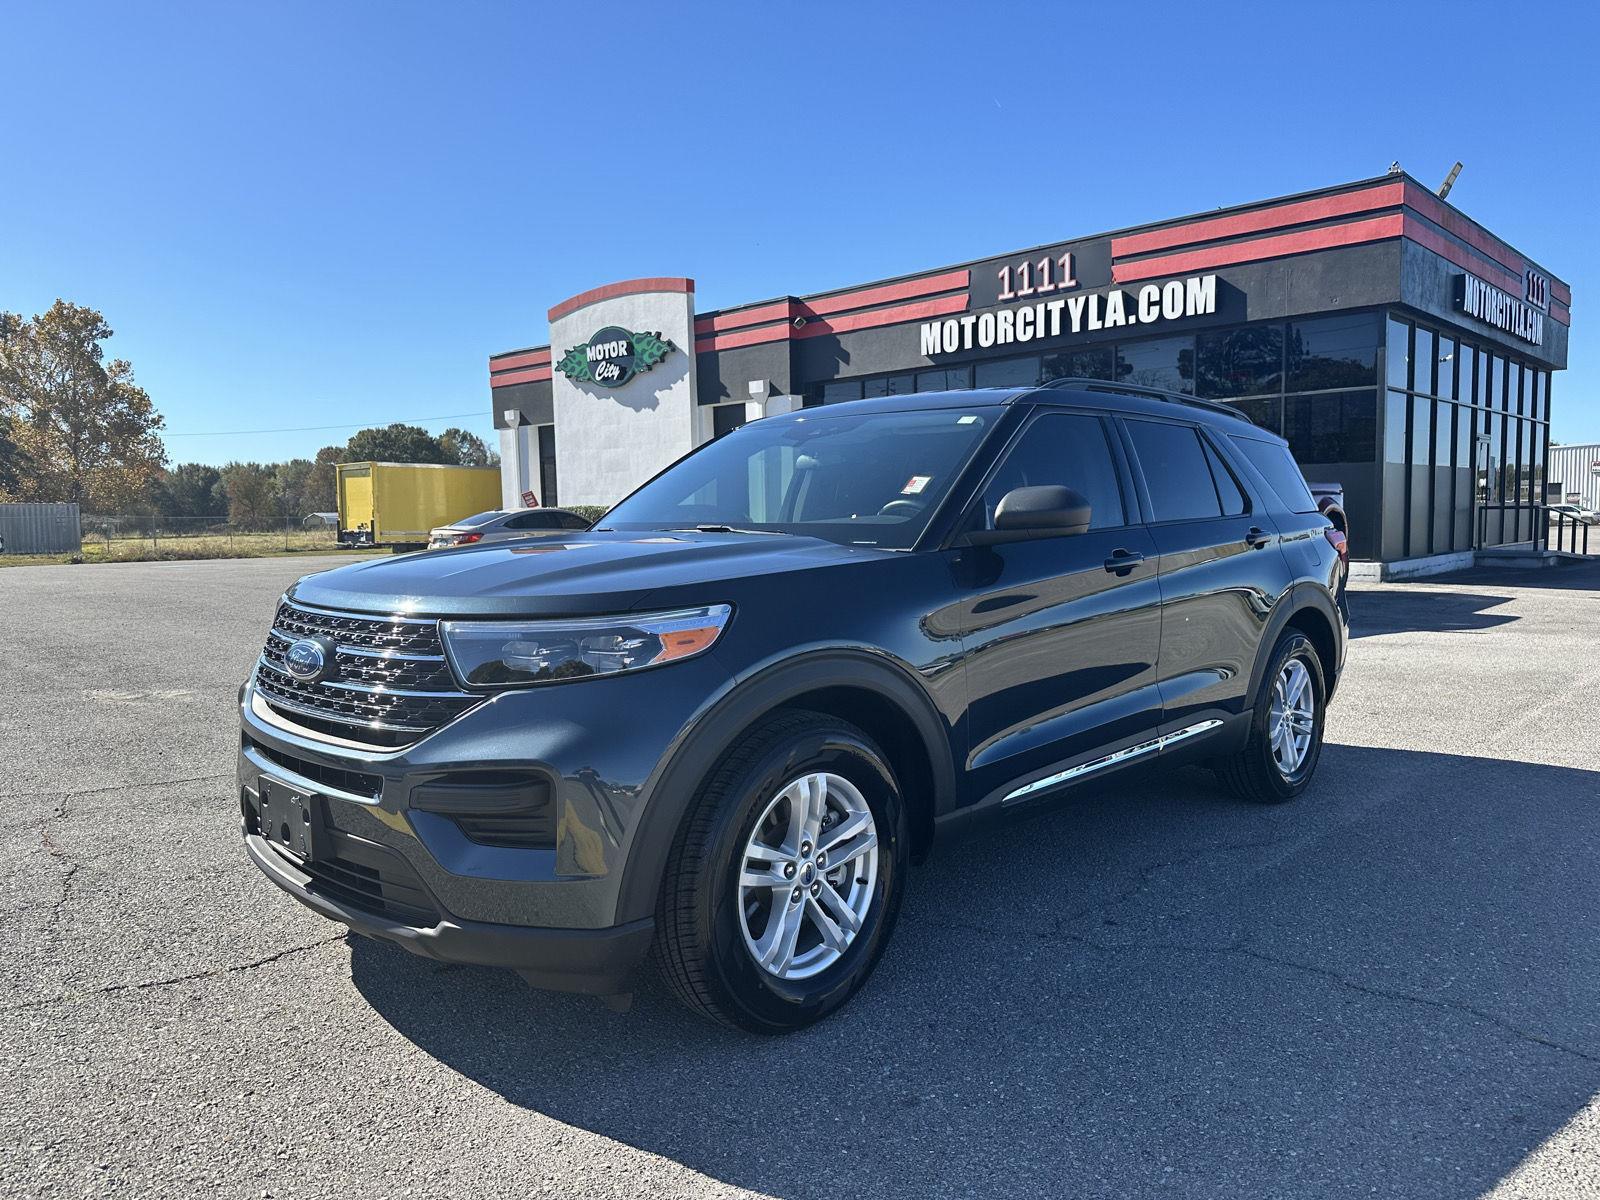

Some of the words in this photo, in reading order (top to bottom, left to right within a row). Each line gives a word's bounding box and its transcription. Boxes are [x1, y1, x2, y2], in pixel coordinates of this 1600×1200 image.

[998, 252, 1077, 300] 1111
[1528, 270, 1546, 309] 1111
[920, 274, 1217, 356] MOTORCITYLA.COM
[1464, 274, 1543, 346] MOTORCITYLA.COM
[586, 340, 628, 361] MOTOR
[595, 361, 620, 381] City
